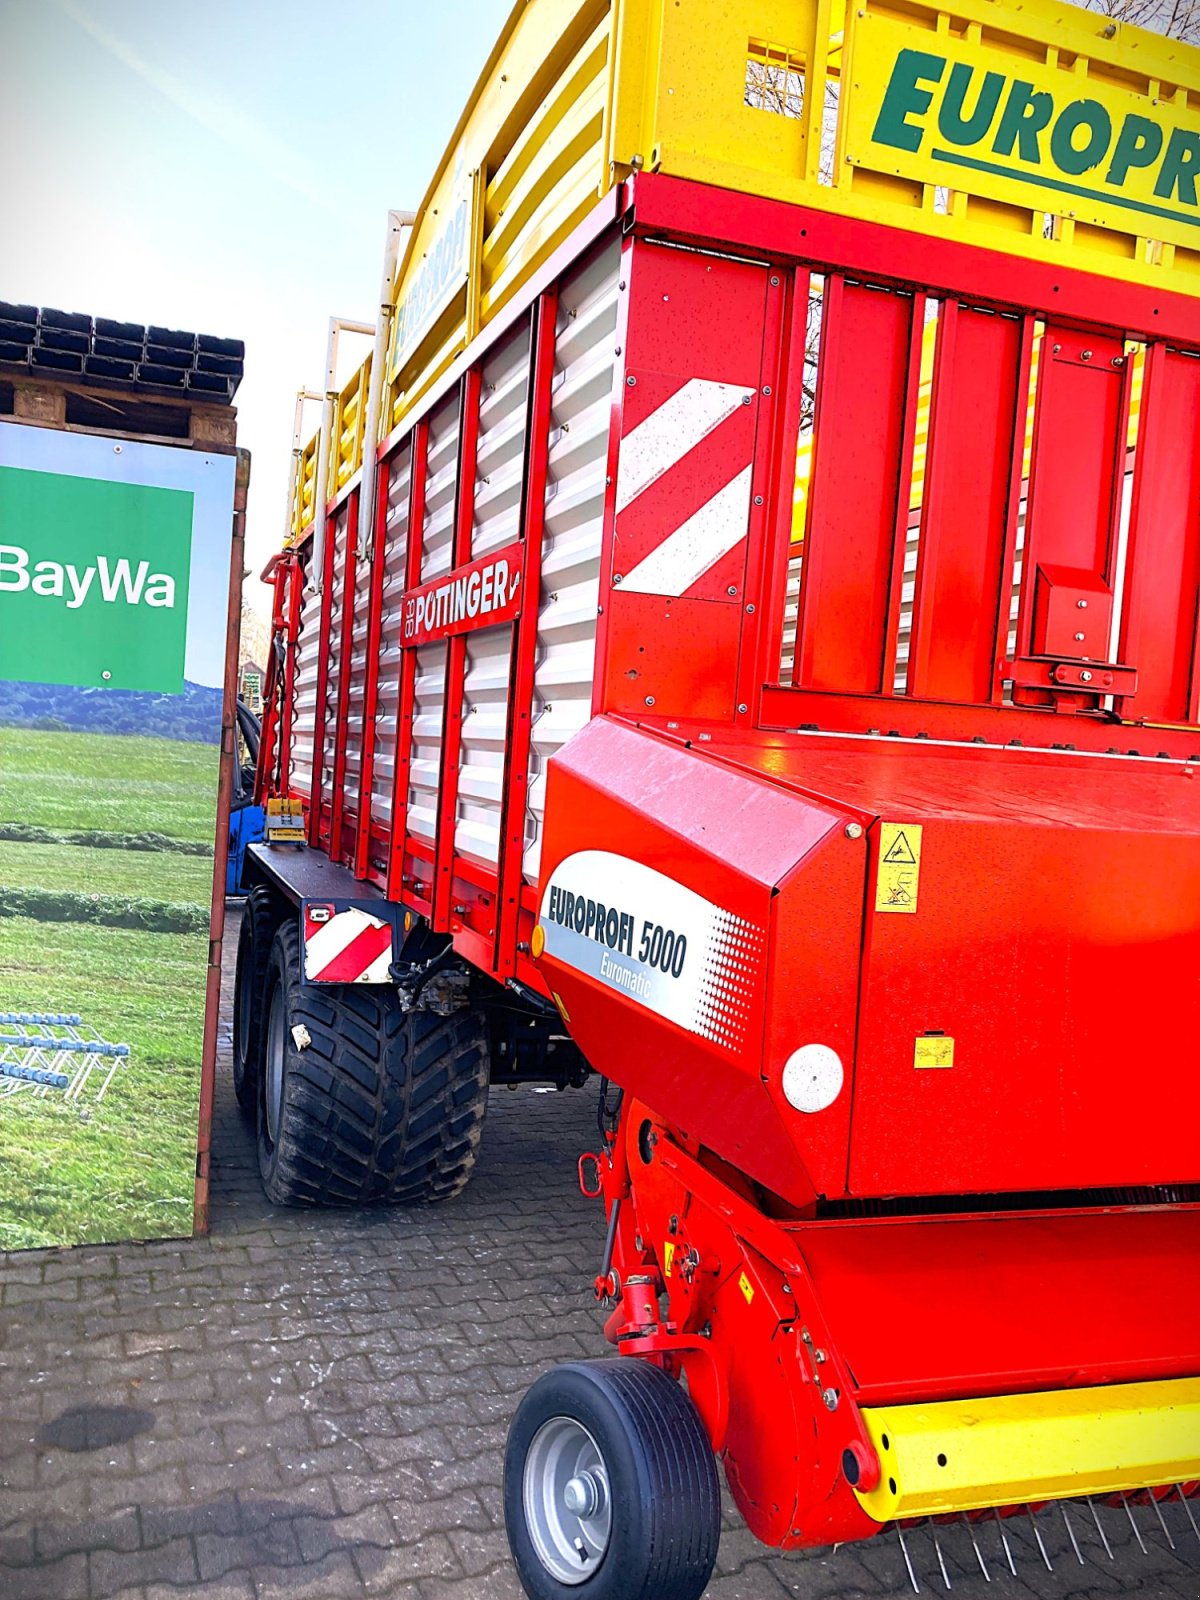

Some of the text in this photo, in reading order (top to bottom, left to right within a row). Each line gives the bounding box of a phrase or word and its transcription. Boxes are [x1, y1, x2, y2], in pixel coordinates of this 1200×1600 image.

[0, 544, 175, 609] BayWa
[549, 885, 687, 979] EUROPROFI 5000
[600, 951, 652, 998] Euromatic
